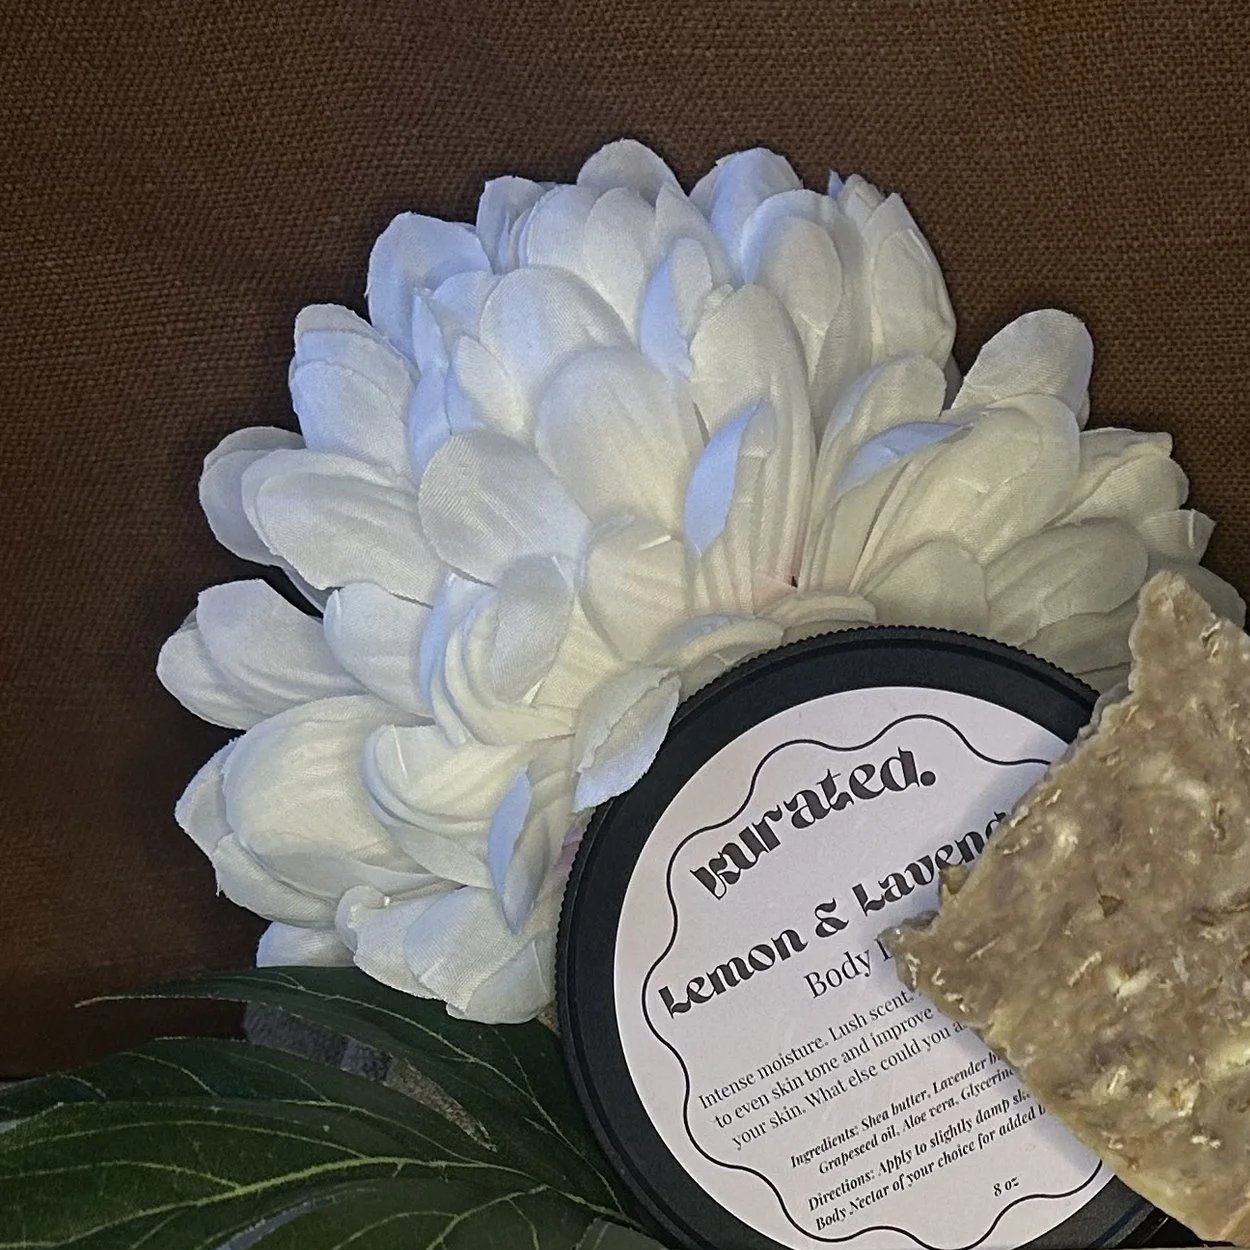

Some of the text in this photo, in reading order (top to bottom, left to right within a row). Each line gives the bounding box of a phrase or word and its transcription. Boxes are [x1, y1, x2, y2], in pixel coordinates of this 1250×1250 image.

[658, 811, 1007, 1018] Lemon & Laven
[804, 948, 874, 998] Body
[698, 990, 915, 1109] Intense moisture. Lush scent.
[715, 1112, 733, 1128] to
[735, 1094, 770, 1119] even
[771, 1074, 805, 1101] skin
[804, 1057, 840, 1082] tone
[841, 1037, 871, 1063] and
[870, 1008, 934, 1047] improve
[732, 1121, 767, 1151] your
[769, 1103, 807, 1129] skin.
[804, 1079, 848, 1108] What
[848, 1064, 879, 1088] else
[880, 1038, 922, 1071] could
[921, 1026, 951, 1052] you
[790, 1126, 859, 1169] Ingredients:
[860, 1110, 890, 1132] Shea
[932, 1059, 987, 1095] Lavender
[808, 1168, 876, 1211] Directions:
[878, 1150, 913, 1177] Apply
[915, 1142, 928, 1156] to
[930, 1117, 974, 1149] slightly
[975, 1097, 1011, 1124] damp
[815, 1207, 847, 1231] Body
[849, 1185, 890, 1215] Nectar
[892, 1173, 906, 1192] of
[906, 1161, 935, 1188] your
[937, 1141, 976, 1168] choice
[977, 1130, 997, 1150] for
[999, 1109, 1037, 1136] added
[819, 1133, 879, 1174] Grapeseed
[902, 1113, 927, 1132] Aloe
[993, 1176, 1020, 1197] 8 oz
